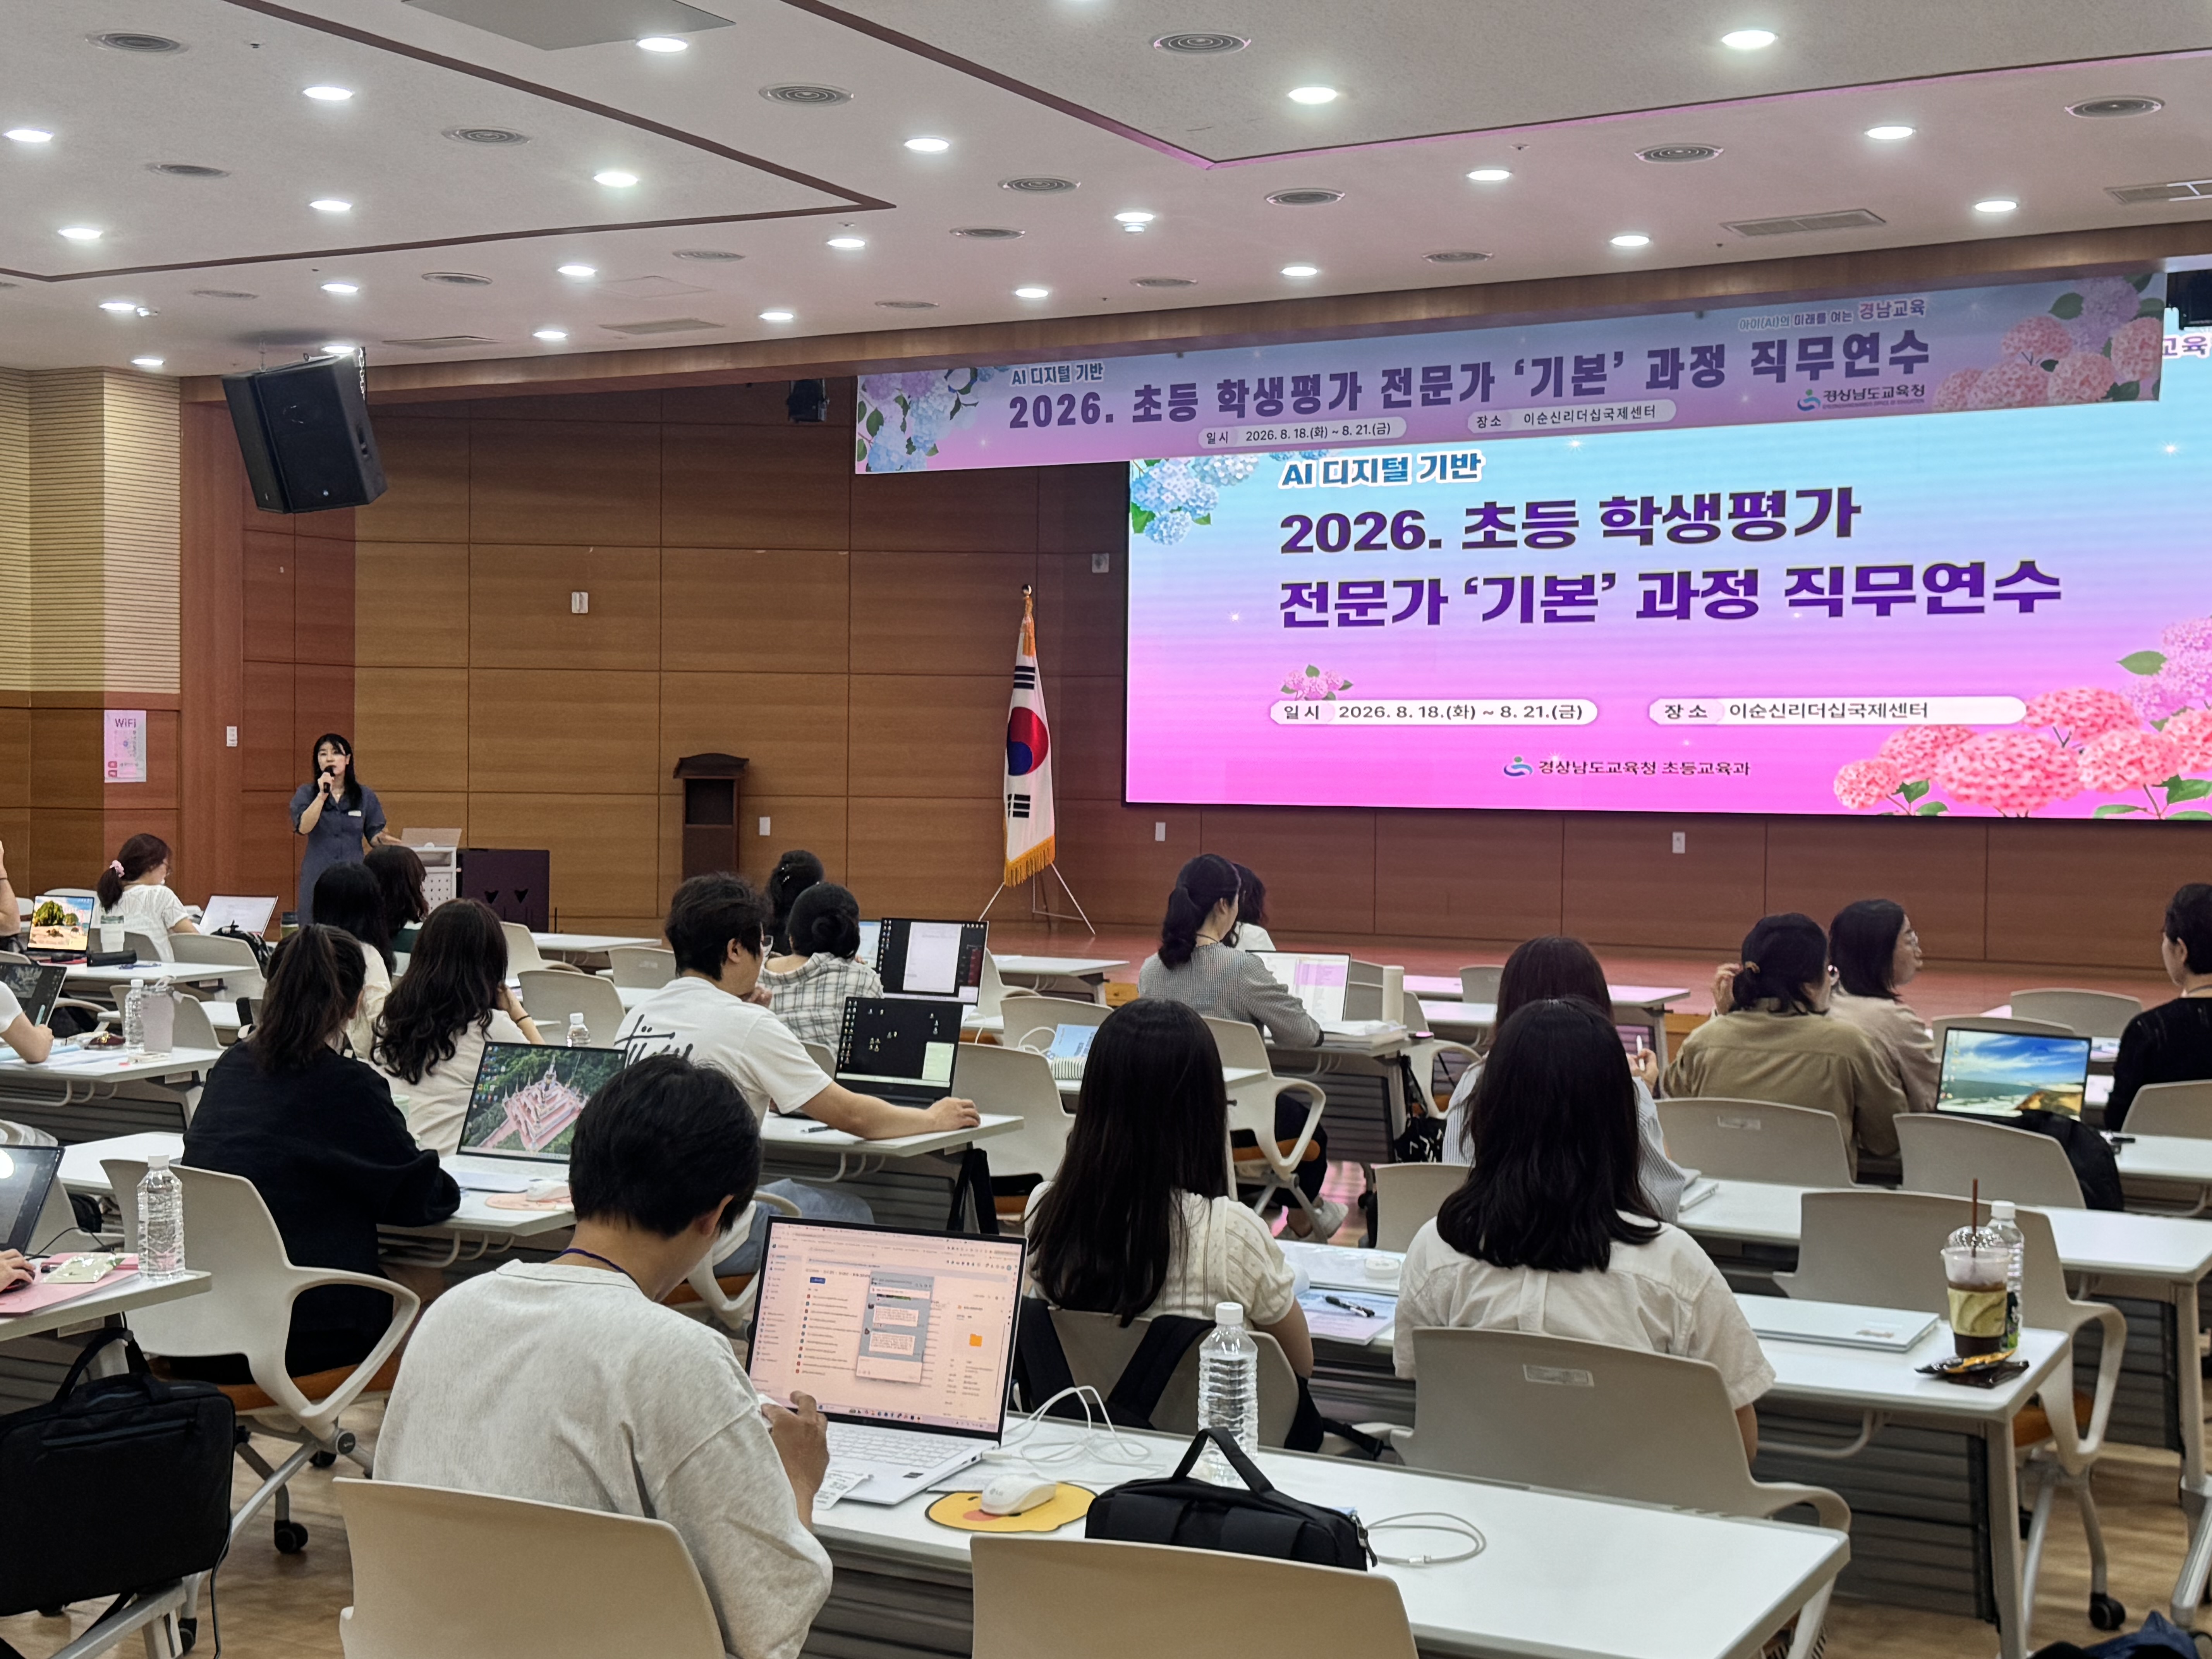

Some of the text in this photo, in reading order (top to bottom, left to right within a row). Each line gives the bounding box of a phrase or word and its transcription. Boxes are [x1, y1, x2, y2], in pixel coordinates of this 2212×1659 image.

[1794, 313, 1826, 325] 미래를
[1831, 311, 1852, 322] 여는
[1860, 299, 1924, 319] 경남교육
[1010, 392, 1113, 428] 2026.
[1133, 383, 1198, 422] 초등
[1217, 372, 1362, 418] 학생평가
[1381, 362, 1495, 409] 전문가
[1646, 344, 1725, 390] 과정
[1751, 330, 1929, 383] 직무연수
[1012, 363, 1103, 385] AI 디지털 기반
[1824, 384, 1925, 402] 경상남도교육청
[1524, 405, 1656, 425] 이순신리더십국제센터
[1246, 430, 1277, 441] 2026.
[1282, 453, 1481, 486] AI 디지털 기반
[1280, 487, 1861, 553] 2026. 초등 학생평가
[1280, 578, 1448, 628] 전문가
[1637, 569, 1759, 620] 과정
[1785, 560, 2061, 618] 직무연수
[1339, 706, 1391, 718] 2026.
[1730, 702, 1928, 719] 이순신리더십국제센터
[1539, 760, 1750, 775] 경상남도교육청 초등교육과
